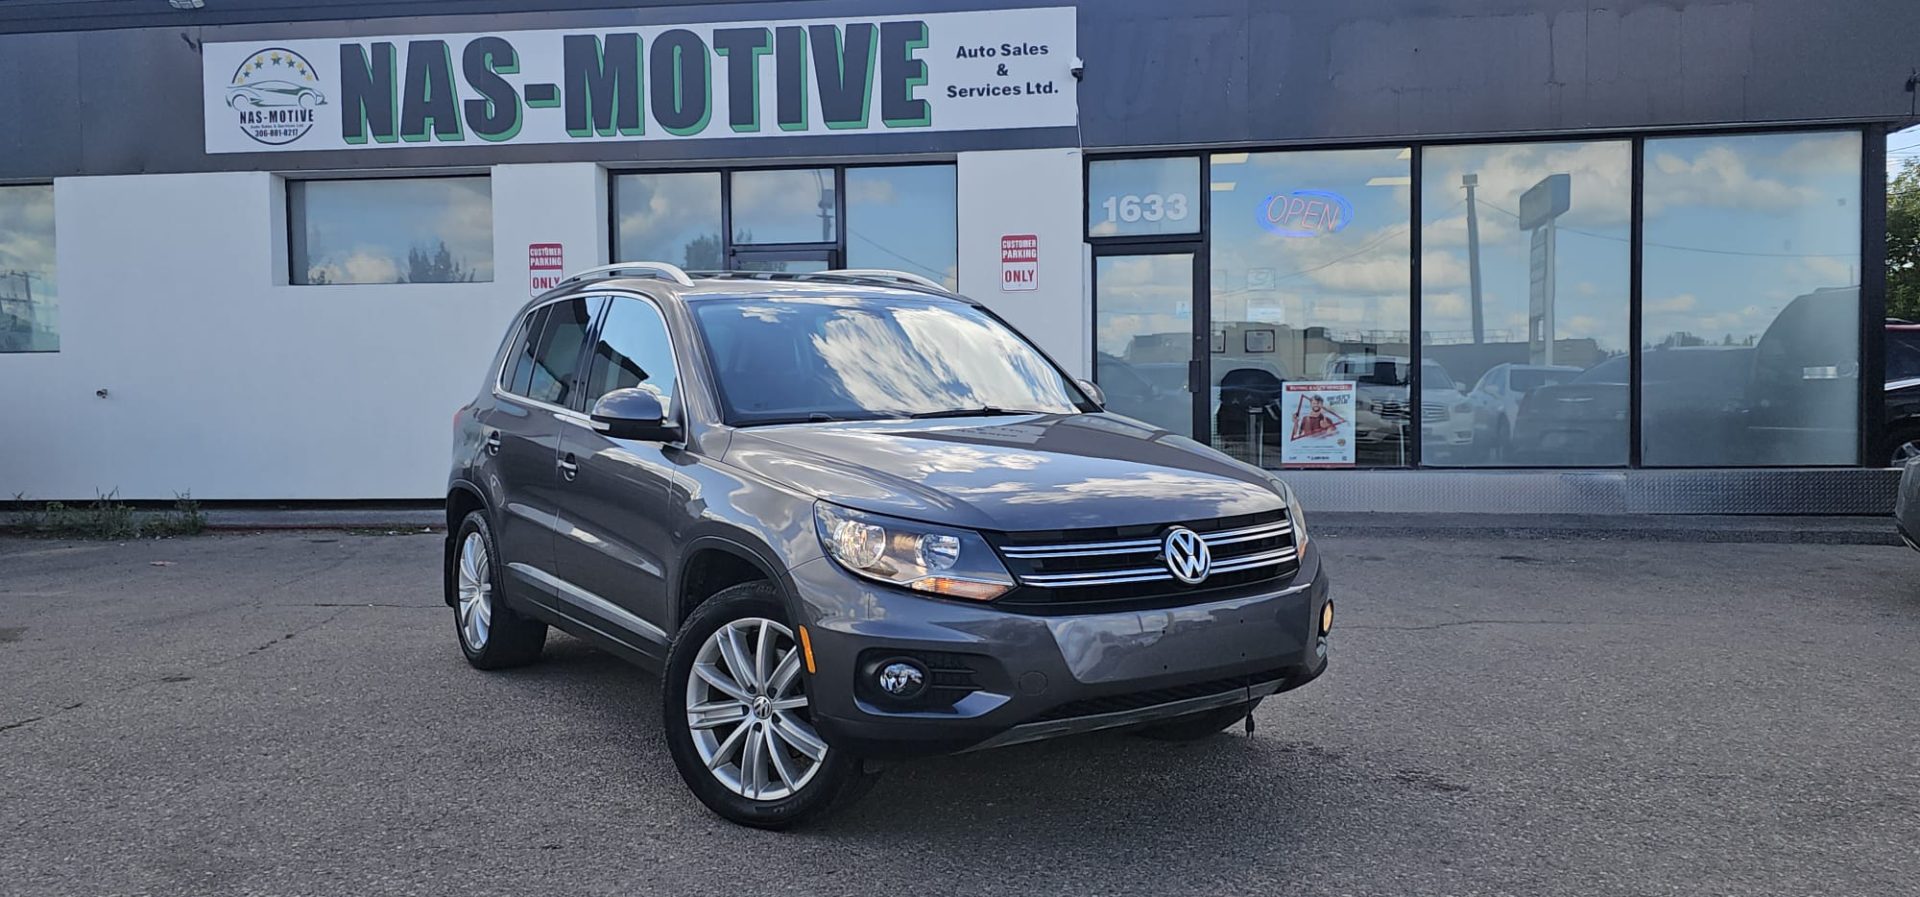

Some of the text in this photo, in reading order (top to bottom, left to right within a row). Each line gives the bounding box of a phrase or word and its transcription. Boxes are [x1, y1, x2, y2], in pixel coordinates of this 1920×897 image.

[956, 43, 1049, 59] Auto Sales
[996, 63, 1009, 77] &
[340, 20, 932, 144] NAS-MOTIVE
[947, 81, 1059, 98] Services Ltd.
[240, 109, 314, 124] NAS-MOTIVE
[1102, 193, 1188, 223] 1633
[1267, 195, 1340, 231] OPEN
[1002, 240, 1036, 249] CUSTOMER
[530, 248, 562, 256] CUSTOMER
[1003, 249, 1036, 259] PARKING
[530, 257, 562, 266] PARKING
[533, 277, 560, 289] ONLY
[1005, 270, 1034, 282] ONLY
[1166, 528, 1211, 584] VW
